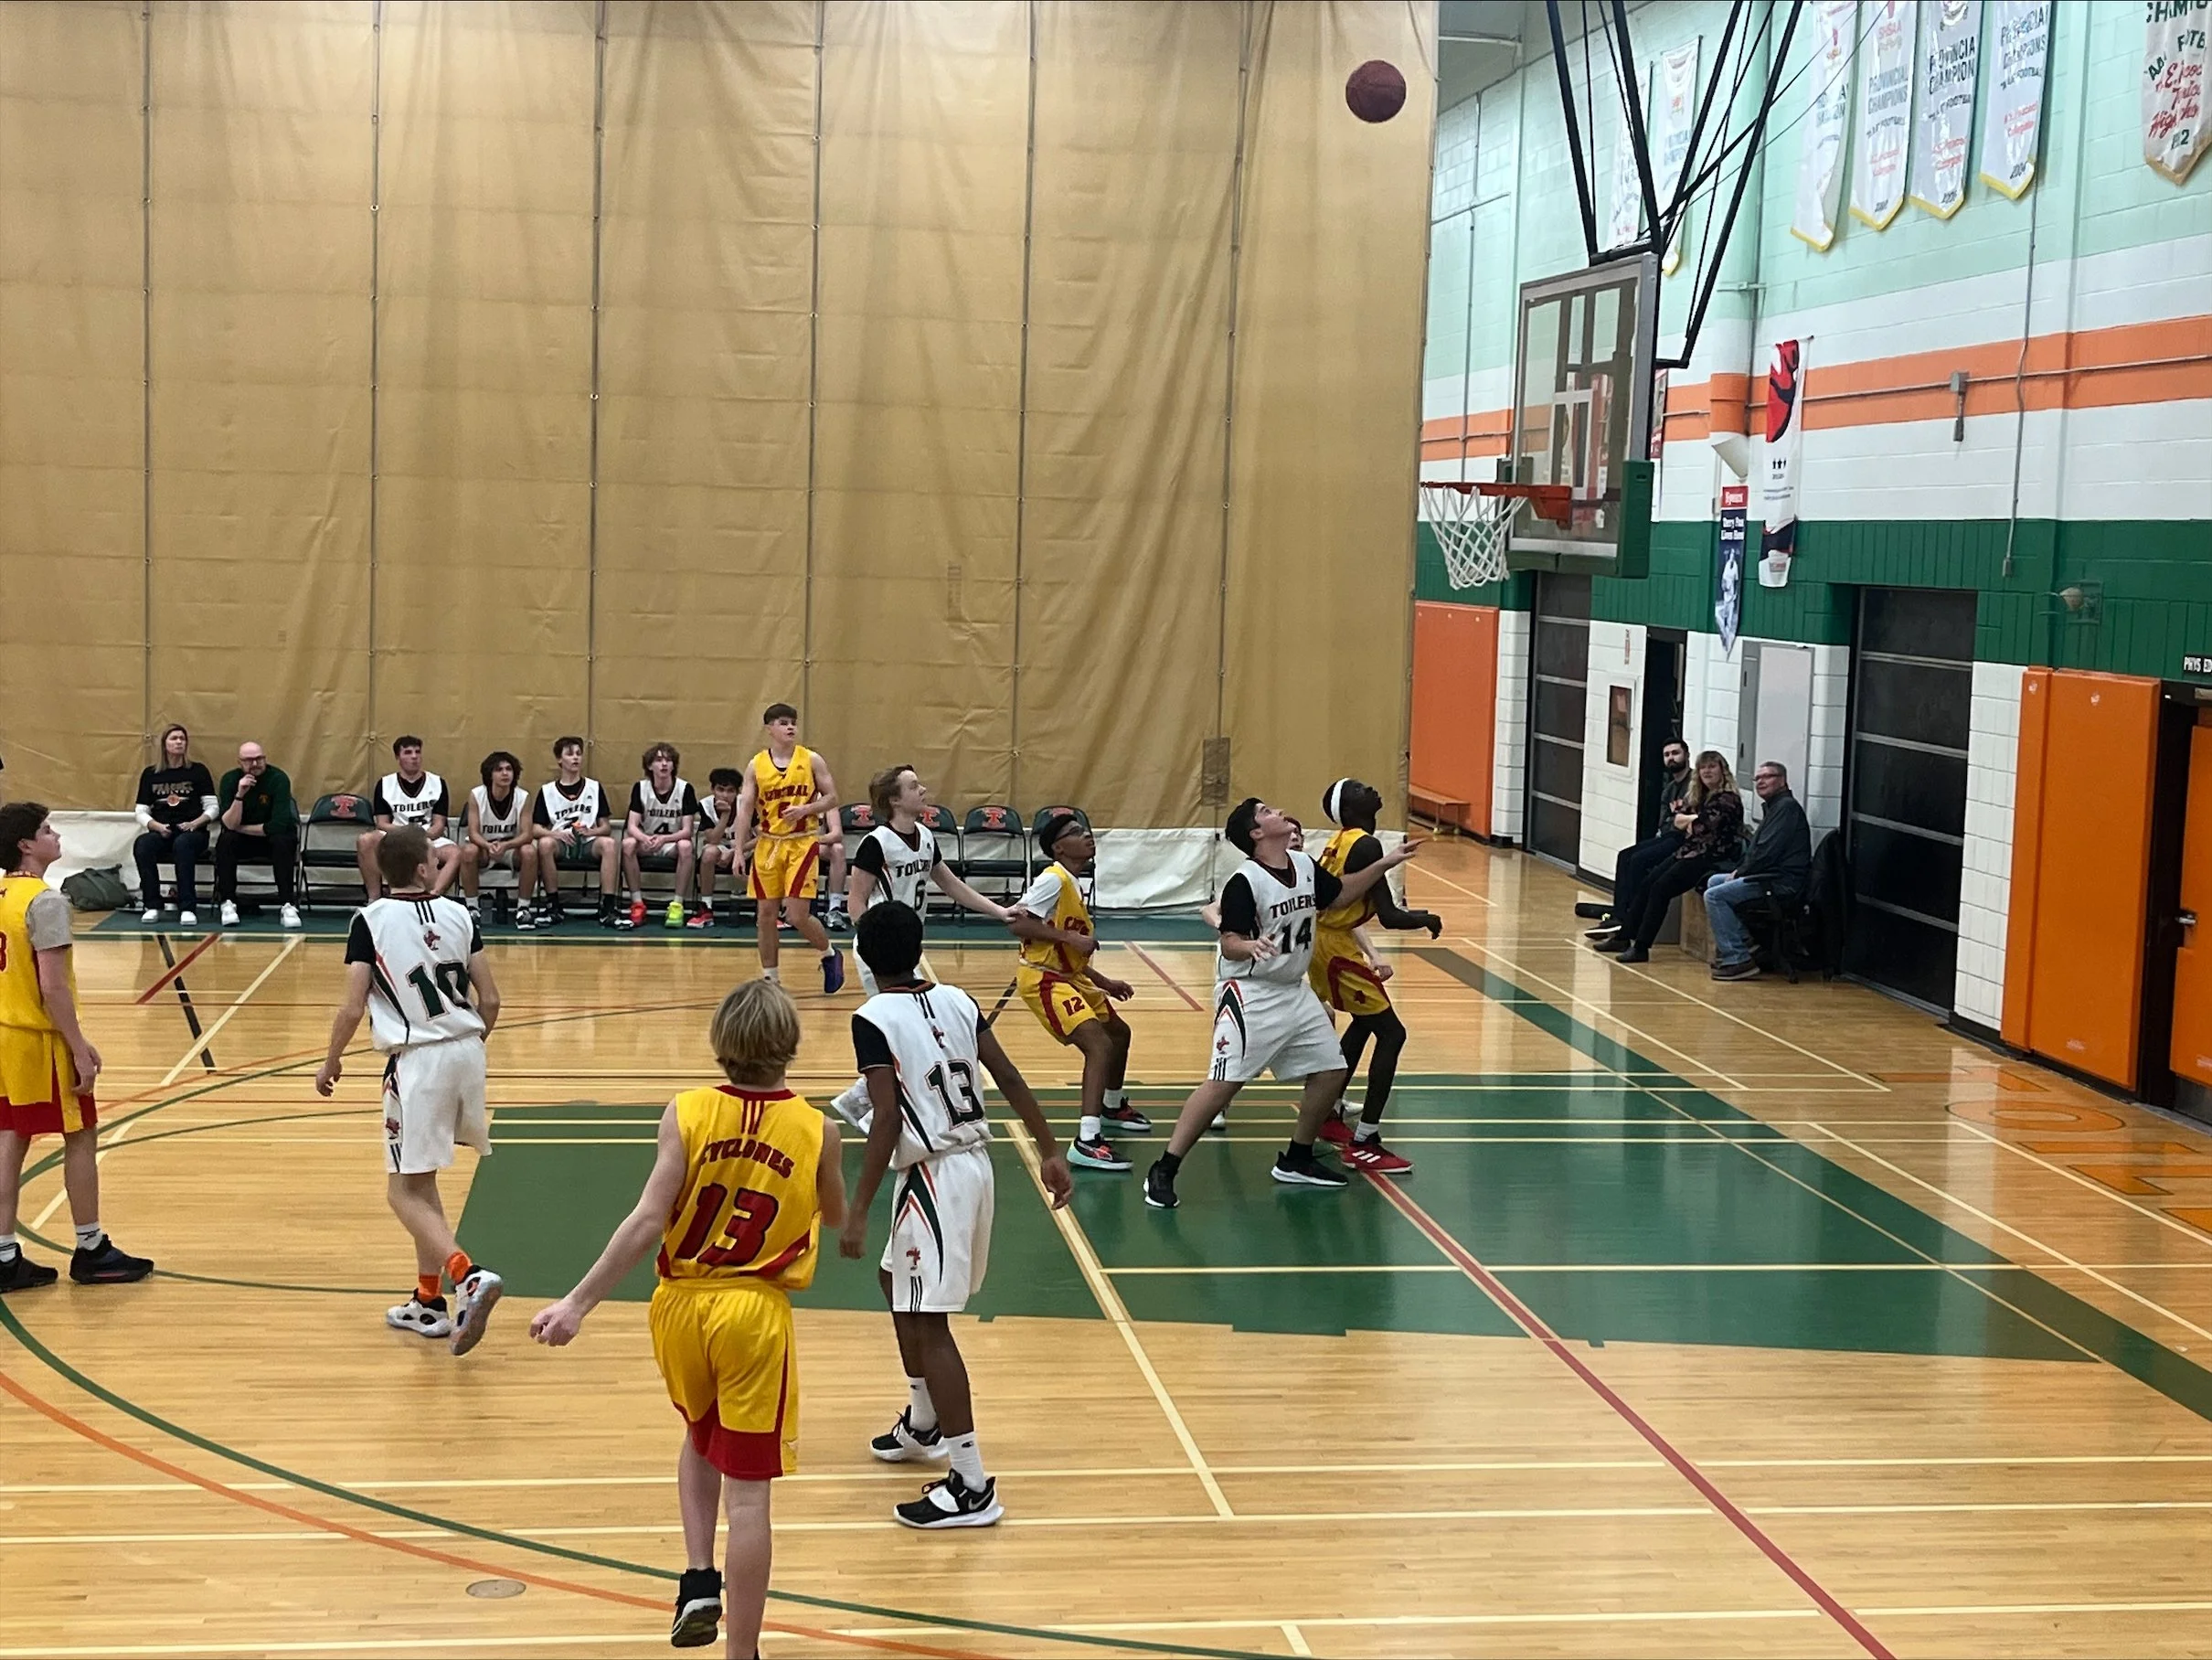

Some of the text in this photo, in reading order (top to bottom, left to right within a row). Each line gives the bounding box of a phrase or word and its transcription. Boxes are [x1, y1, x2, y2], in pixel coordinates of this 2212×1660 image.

[915, 879, 926, 911] 6
[1281, 917, 1313, 954] 14
[406, 961, 473, 1021] 10
[1062, 996, 1085, 1016] 12
[924, 1059, 986, 1132] 13
[700, 1138, 794, 1179] CYCLONES
[673, 1182, 780, 1267] 13
